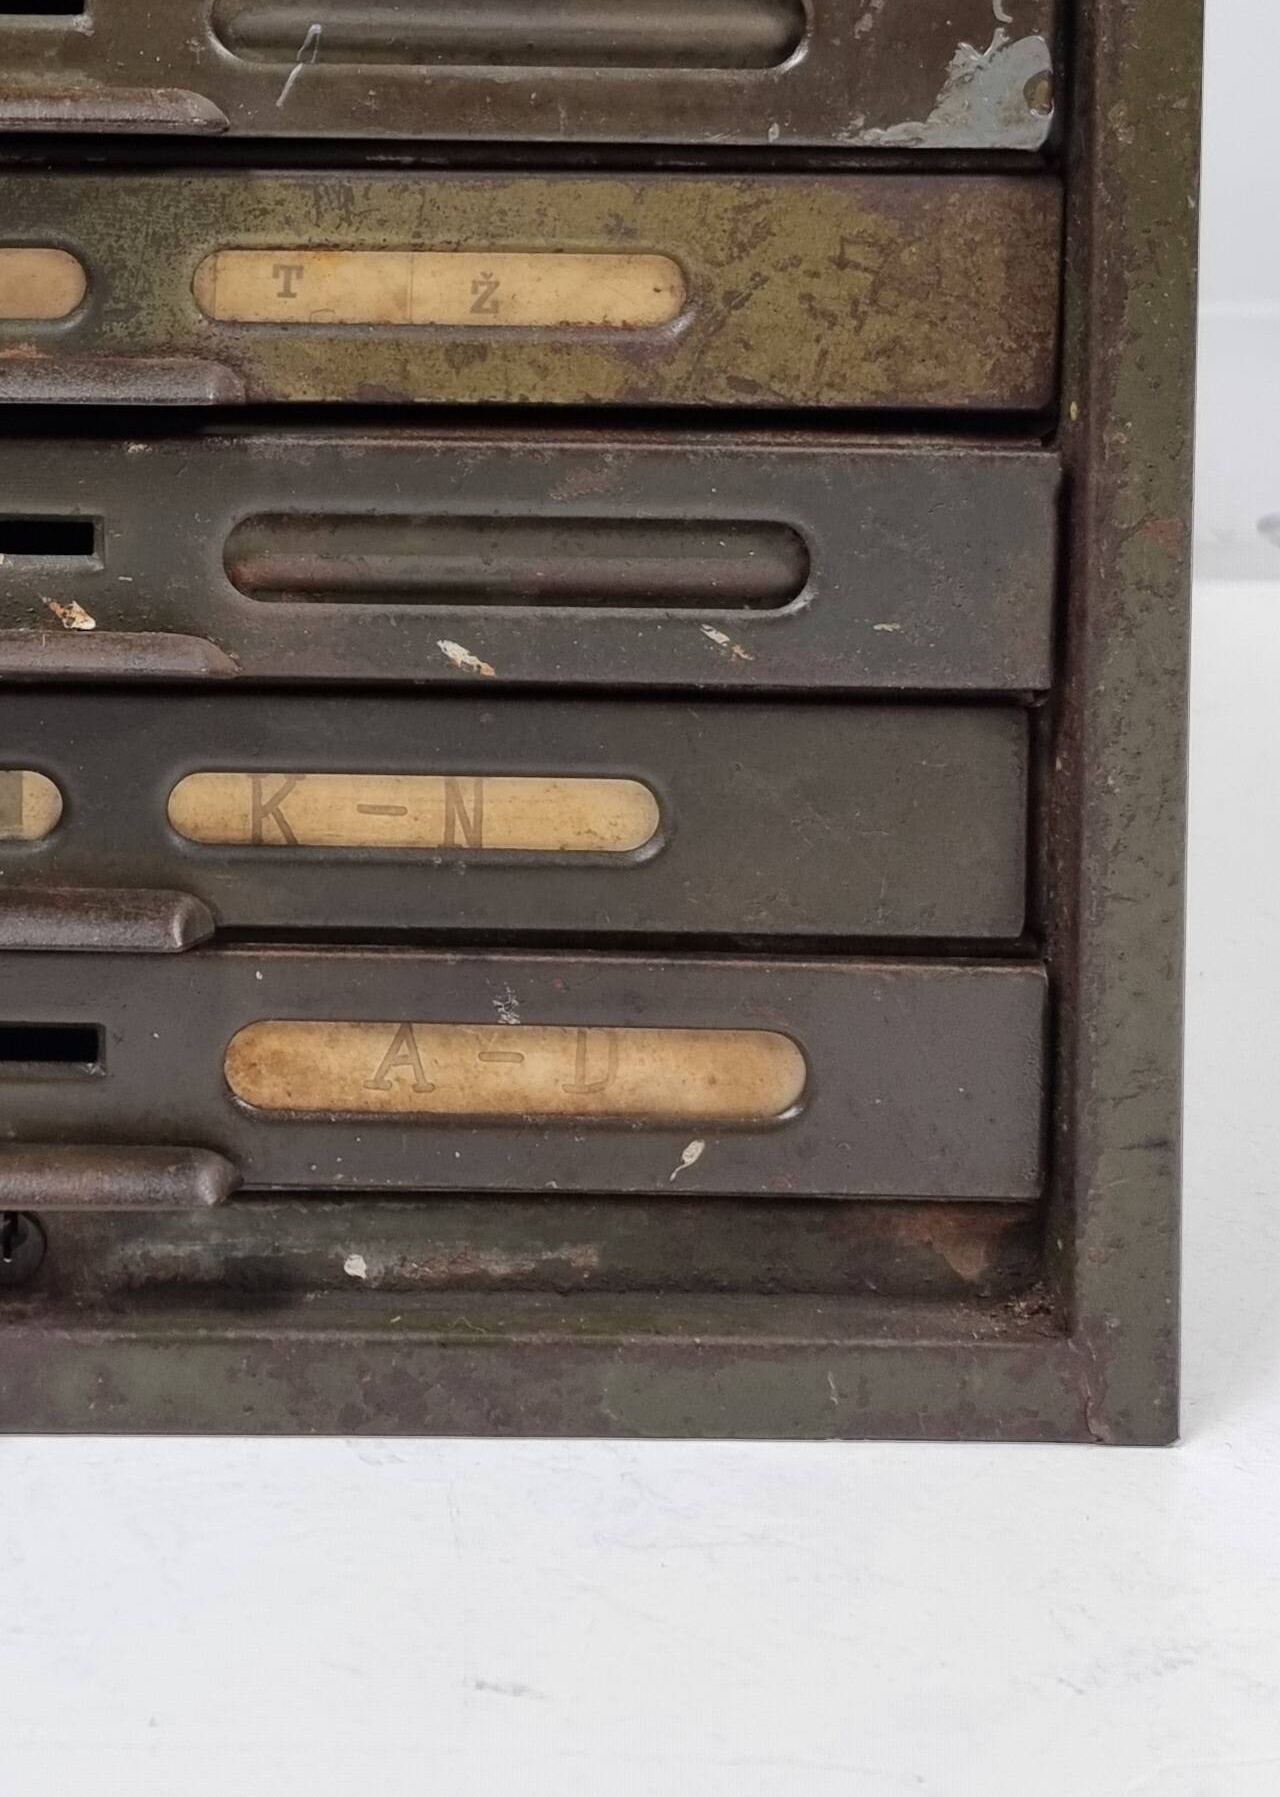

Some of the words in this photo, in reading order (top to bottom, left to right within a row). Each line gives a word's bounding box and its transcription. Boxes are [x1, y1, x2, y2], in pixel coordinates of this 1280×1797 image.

[272, 264, 303, 299] T
[247, 773, 306, 845] K
[438, 776, 484, 849] N
[363, 1022, 435, 1093] A
